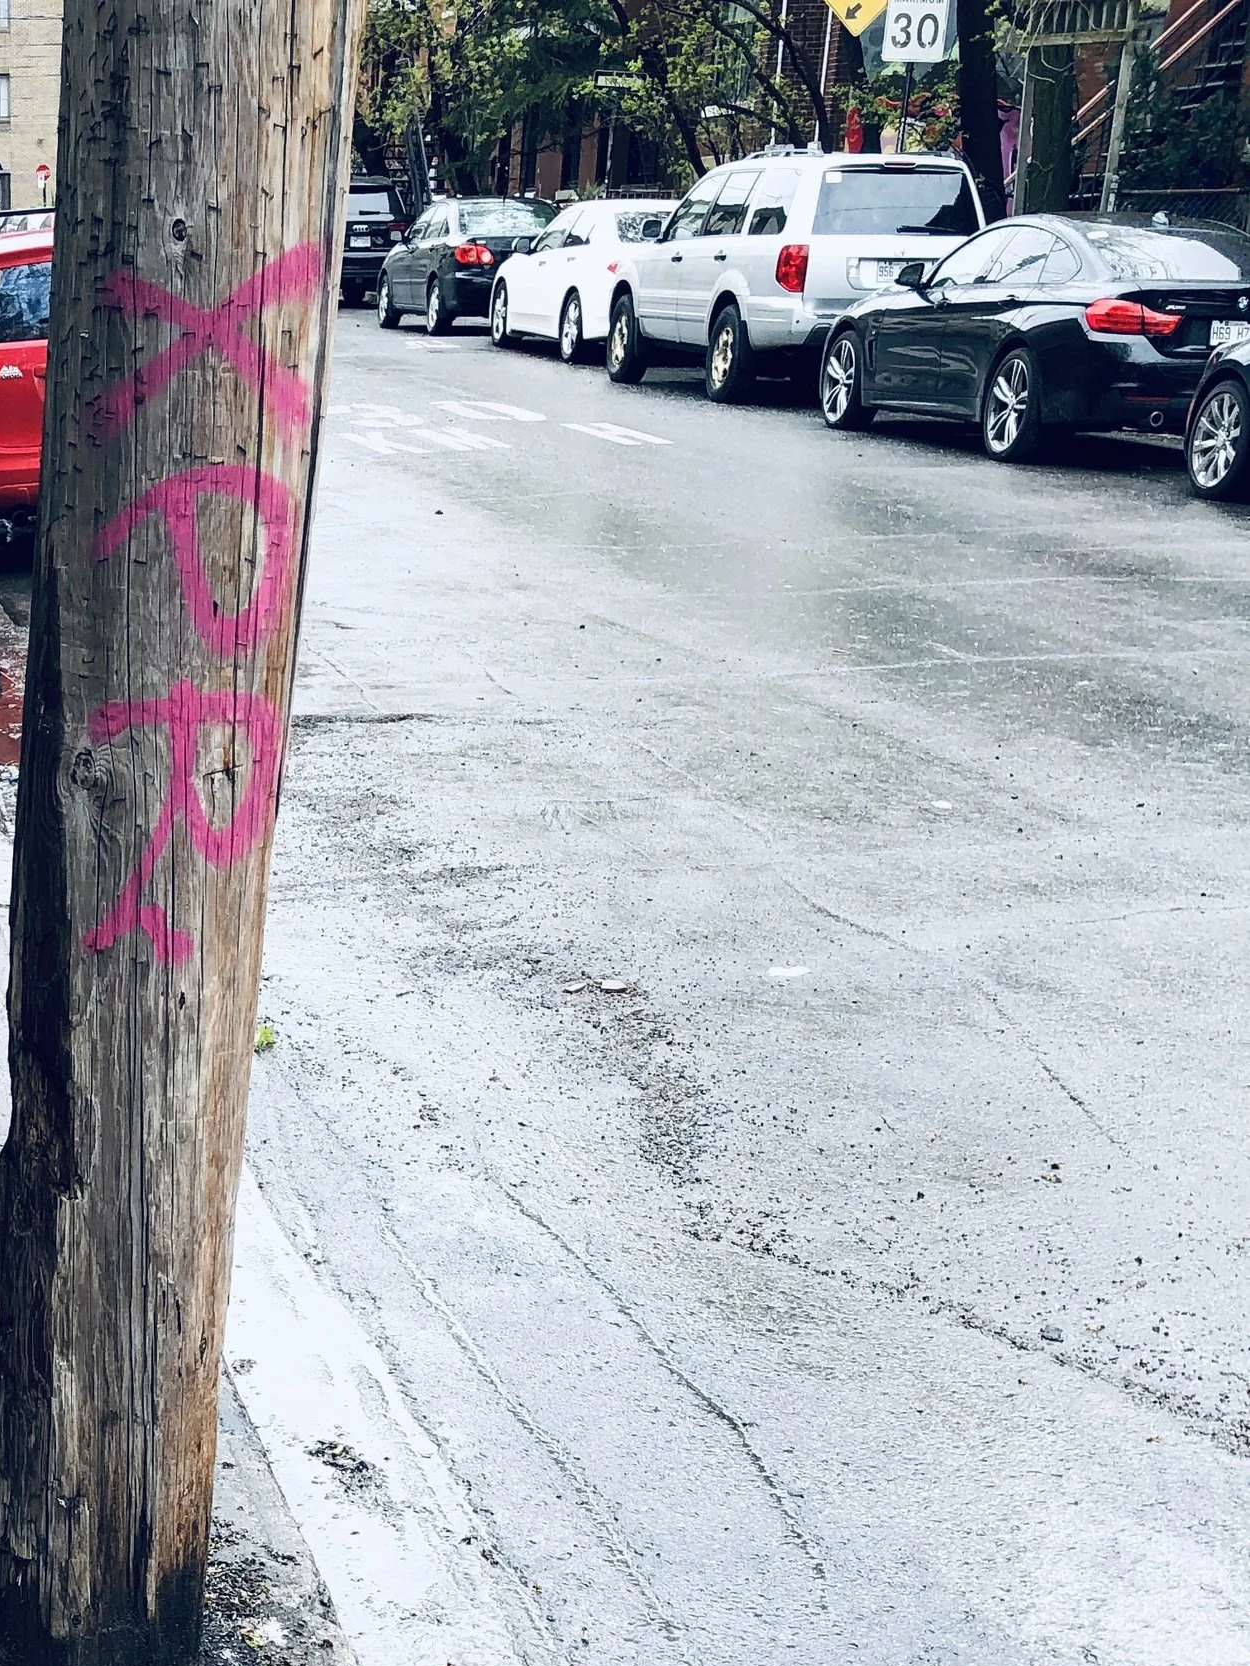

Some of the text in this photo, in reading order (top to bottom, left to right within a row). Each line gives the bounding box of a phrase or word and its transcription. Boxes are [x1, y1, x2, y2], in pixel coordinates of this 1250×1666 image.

[891, 13, 939, 49] 30
[878, 265, 894, 277] 956
[1212, 326, 1231, 340] H69
